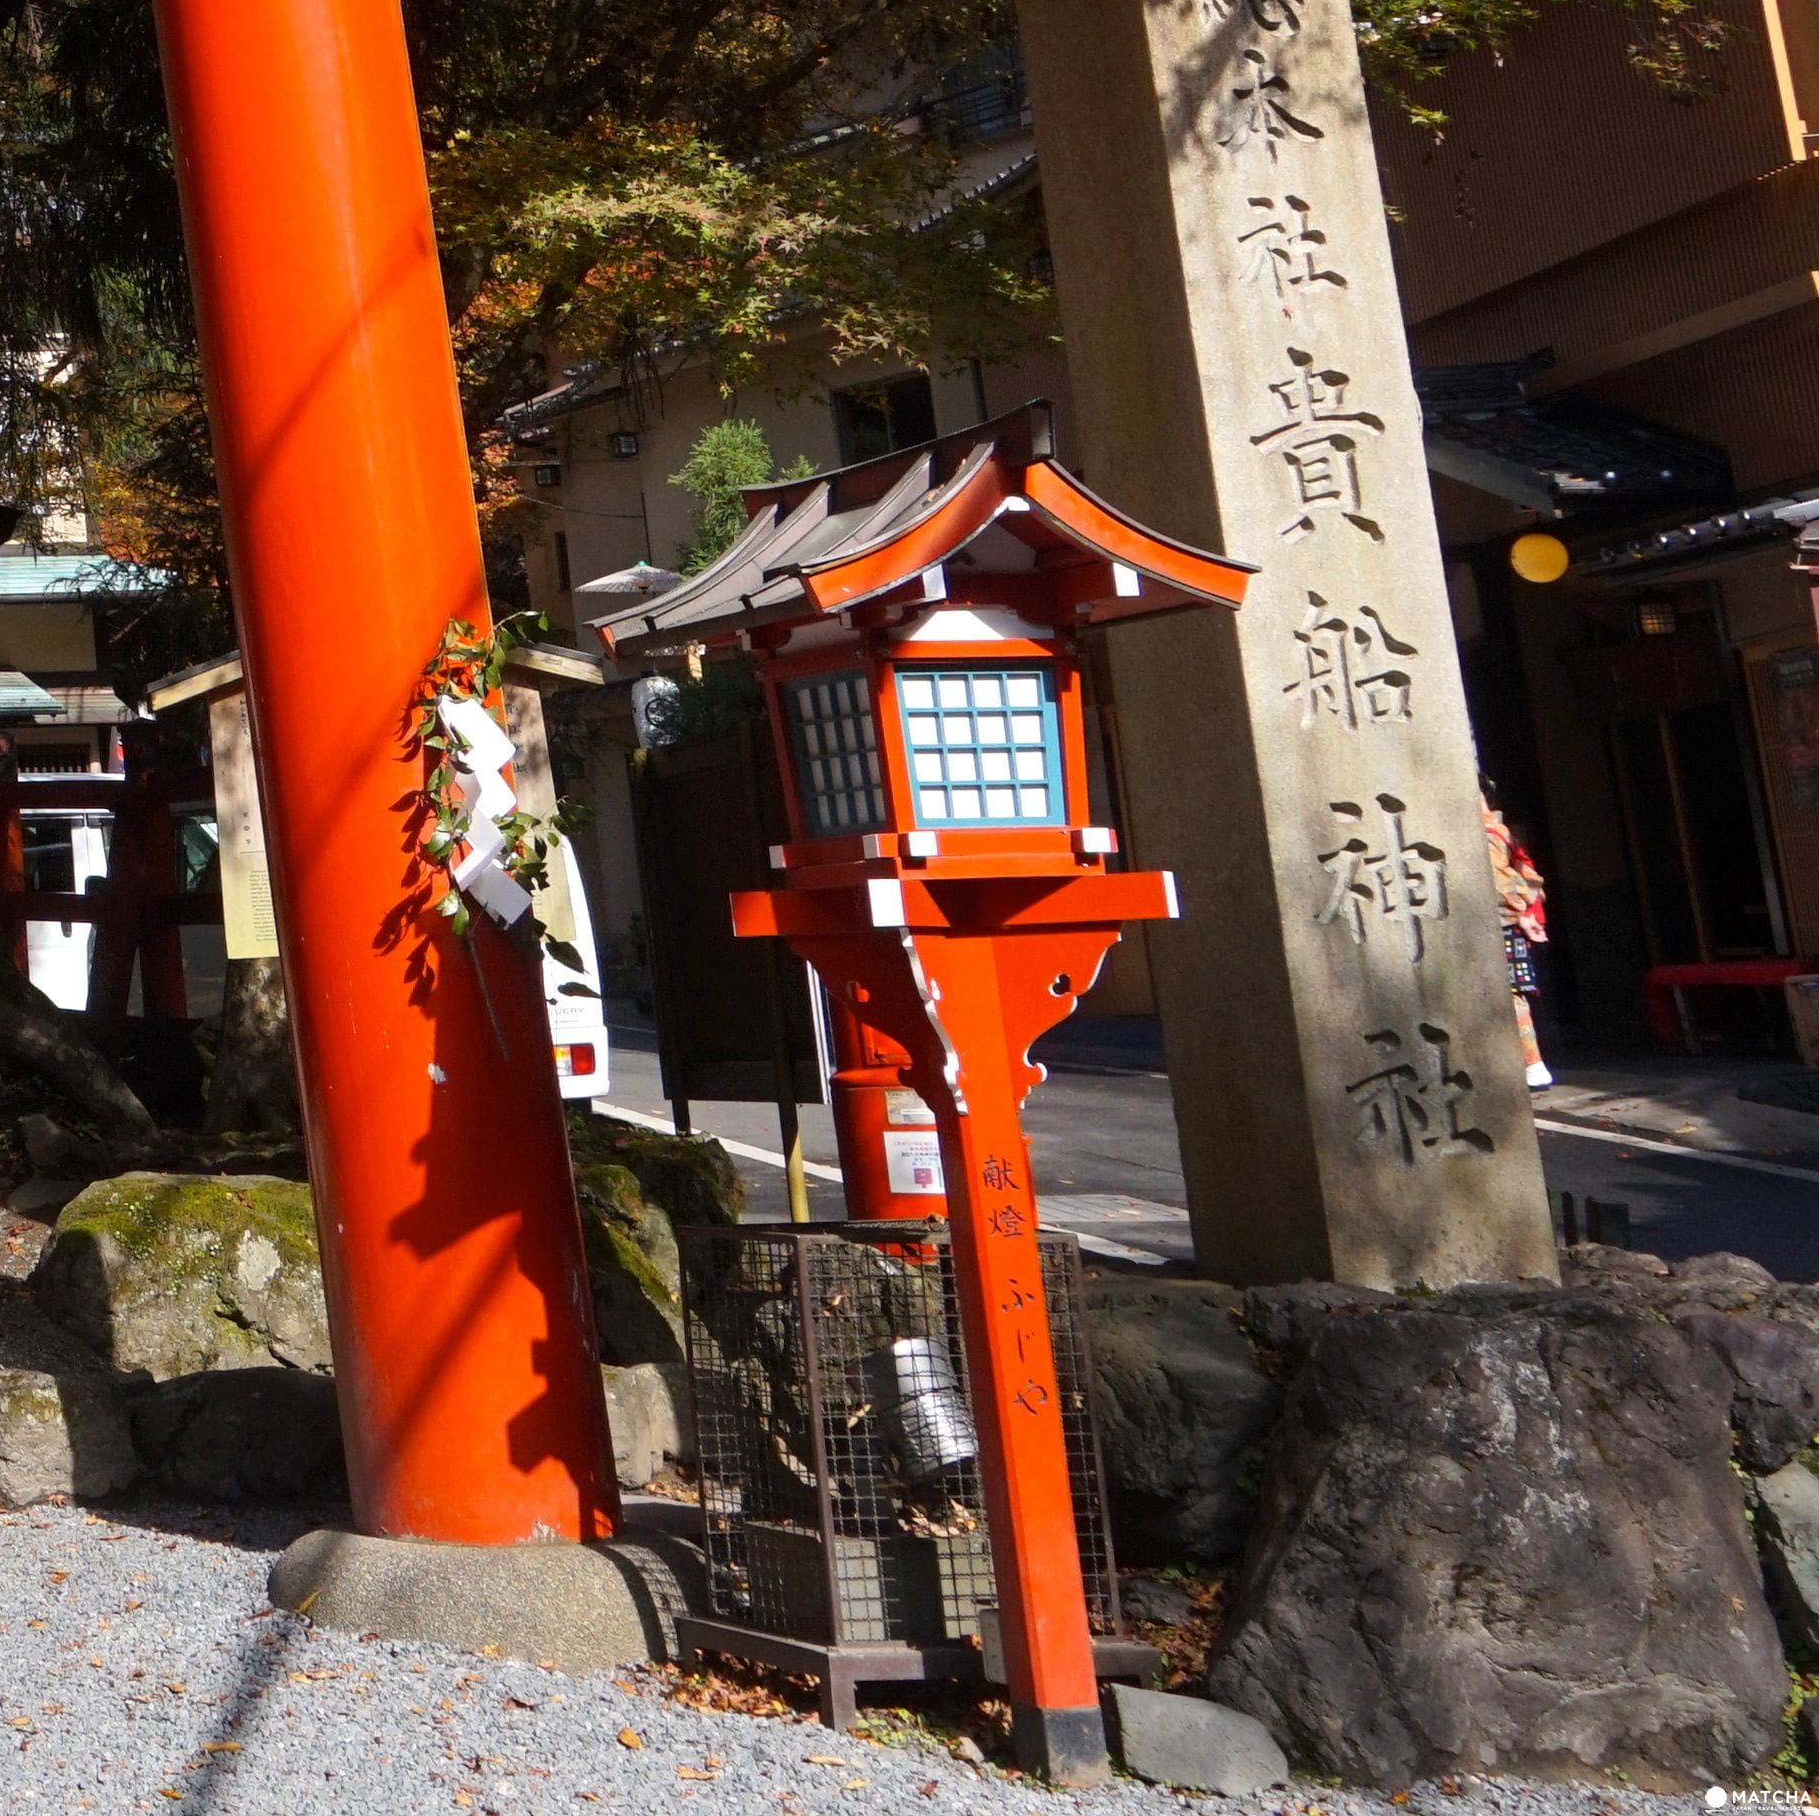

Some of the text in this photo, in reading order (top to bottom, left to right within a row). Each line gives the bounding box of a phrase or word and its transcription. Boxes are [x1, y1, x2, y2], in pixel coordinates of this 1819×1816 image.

[983, 1154, 1048, 1416] 献燈 ふじや
